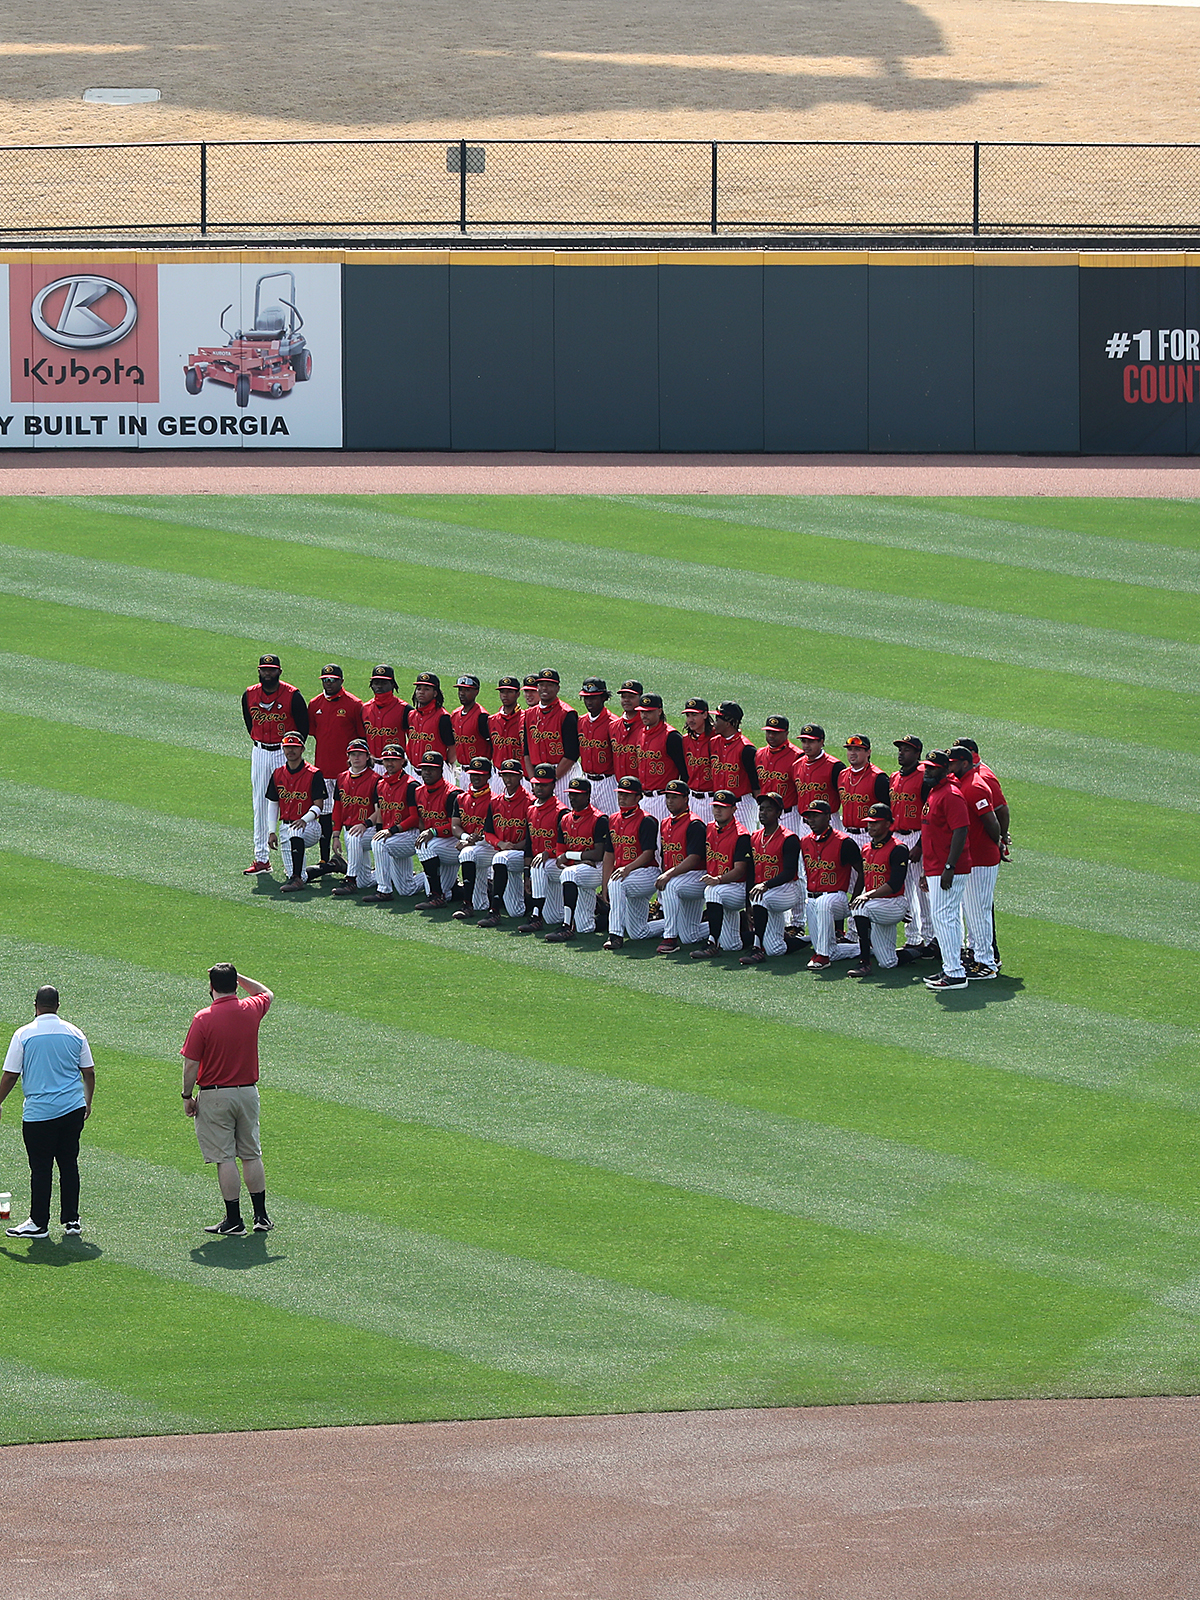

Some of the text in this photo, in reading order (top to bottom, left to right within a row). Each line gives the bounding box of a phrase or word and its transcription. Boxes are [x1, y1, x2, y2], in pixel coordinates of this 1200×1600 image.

[1104, 329, 1200, 361] #1 FOR
[23, 357, 145, 385] Kubota
[24, 415, 108, 436] BUILT
[118, 415, 147, 436] IN
[158, 415, 290, 436] GEORGIA
[250, 707, 287, 725] Tigers
[278, 723, 285, 735] 9
[363, 721, 398, 739] Tigers
[529, 725, 560, 743] Tigers
[468, 746, 477, 759] 2
[549, 742, 564, 755] 32
[598, 751, 606, 764] 6
[710, 755, 739, 774] Tigers
[649, 762, 664, 775] 33
[727, 774, 739, 788] 21
[277, 785, 308, 801] Tigers
[776, 784, 789, 797] 17
[338, 789, 370, 808] Tigers
[297, 803, 302, 815] 1
[358, 808, 368, 821] 11
[904, 805, 917, 818] 12
[493, 813, 527, 831] Tigers
[516, 829, 524, 842] 7
[623, 847, 637, 860] 26
[804, 854, 836, 871] Tigers
[764, 867, 779, 880] 27
[820, 872, 836, 886] 20
